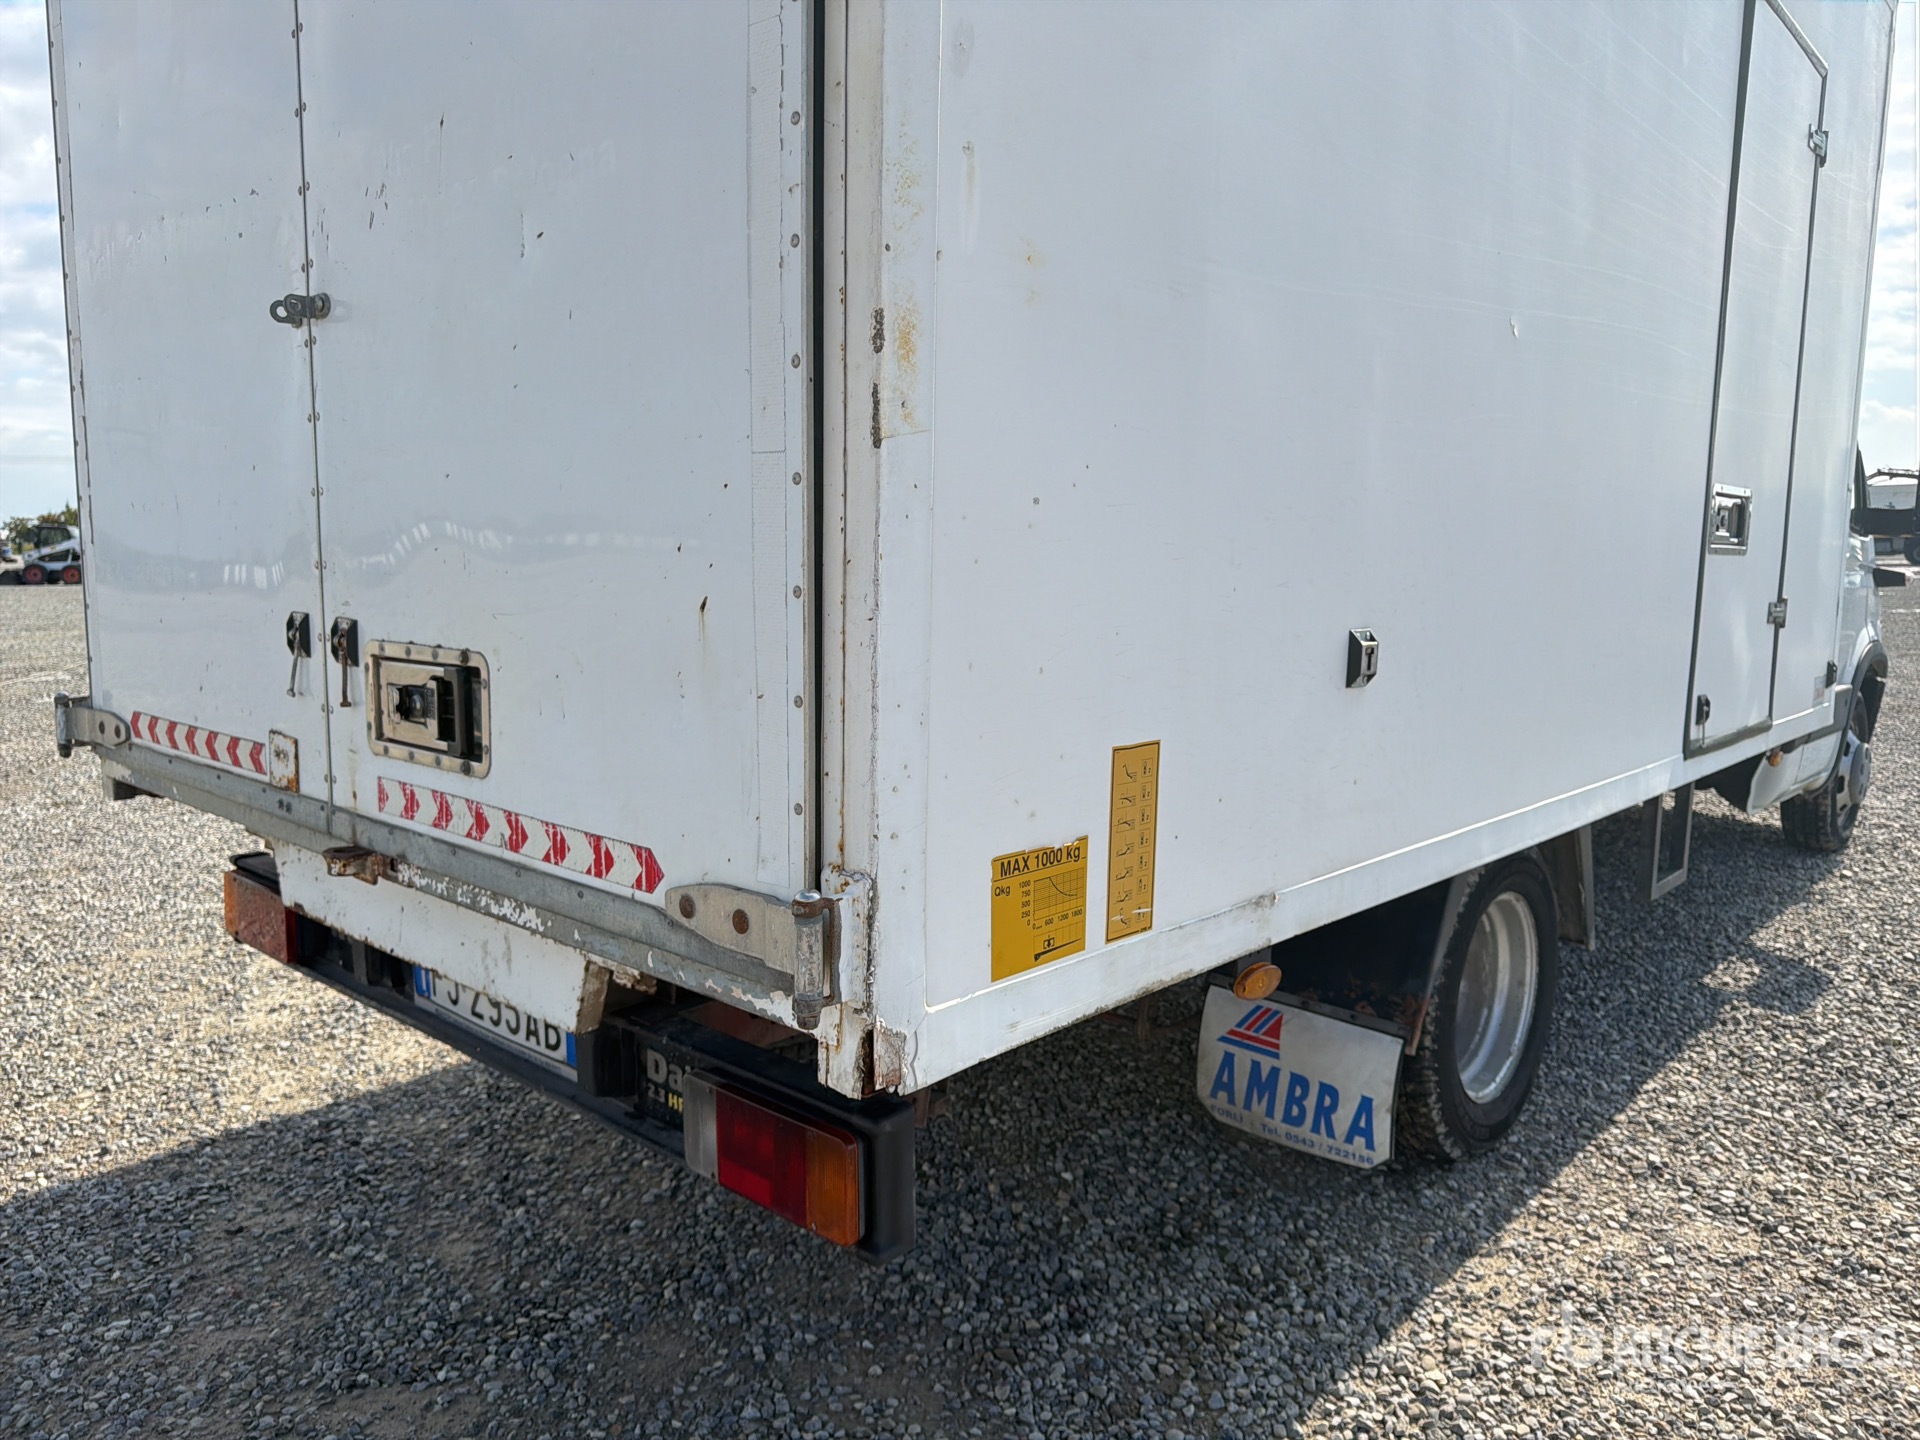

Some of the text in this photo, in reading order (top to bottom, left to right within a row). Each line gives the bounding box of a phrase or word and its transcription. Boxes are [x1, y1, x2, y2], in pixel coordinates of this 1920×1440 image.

[1000, 845, 1081, 878] MAX 1000 kg
[1018, 879, 1031, 889] 1000
[994, 885, 1011, 897] Qkg
[1021, 889, 1031, 898] 750
[1021, 899, 1031, 909] 500
[1021, 910, 1031, 919] 250
[1210, 1050, 1376, 1152] AMBRA
